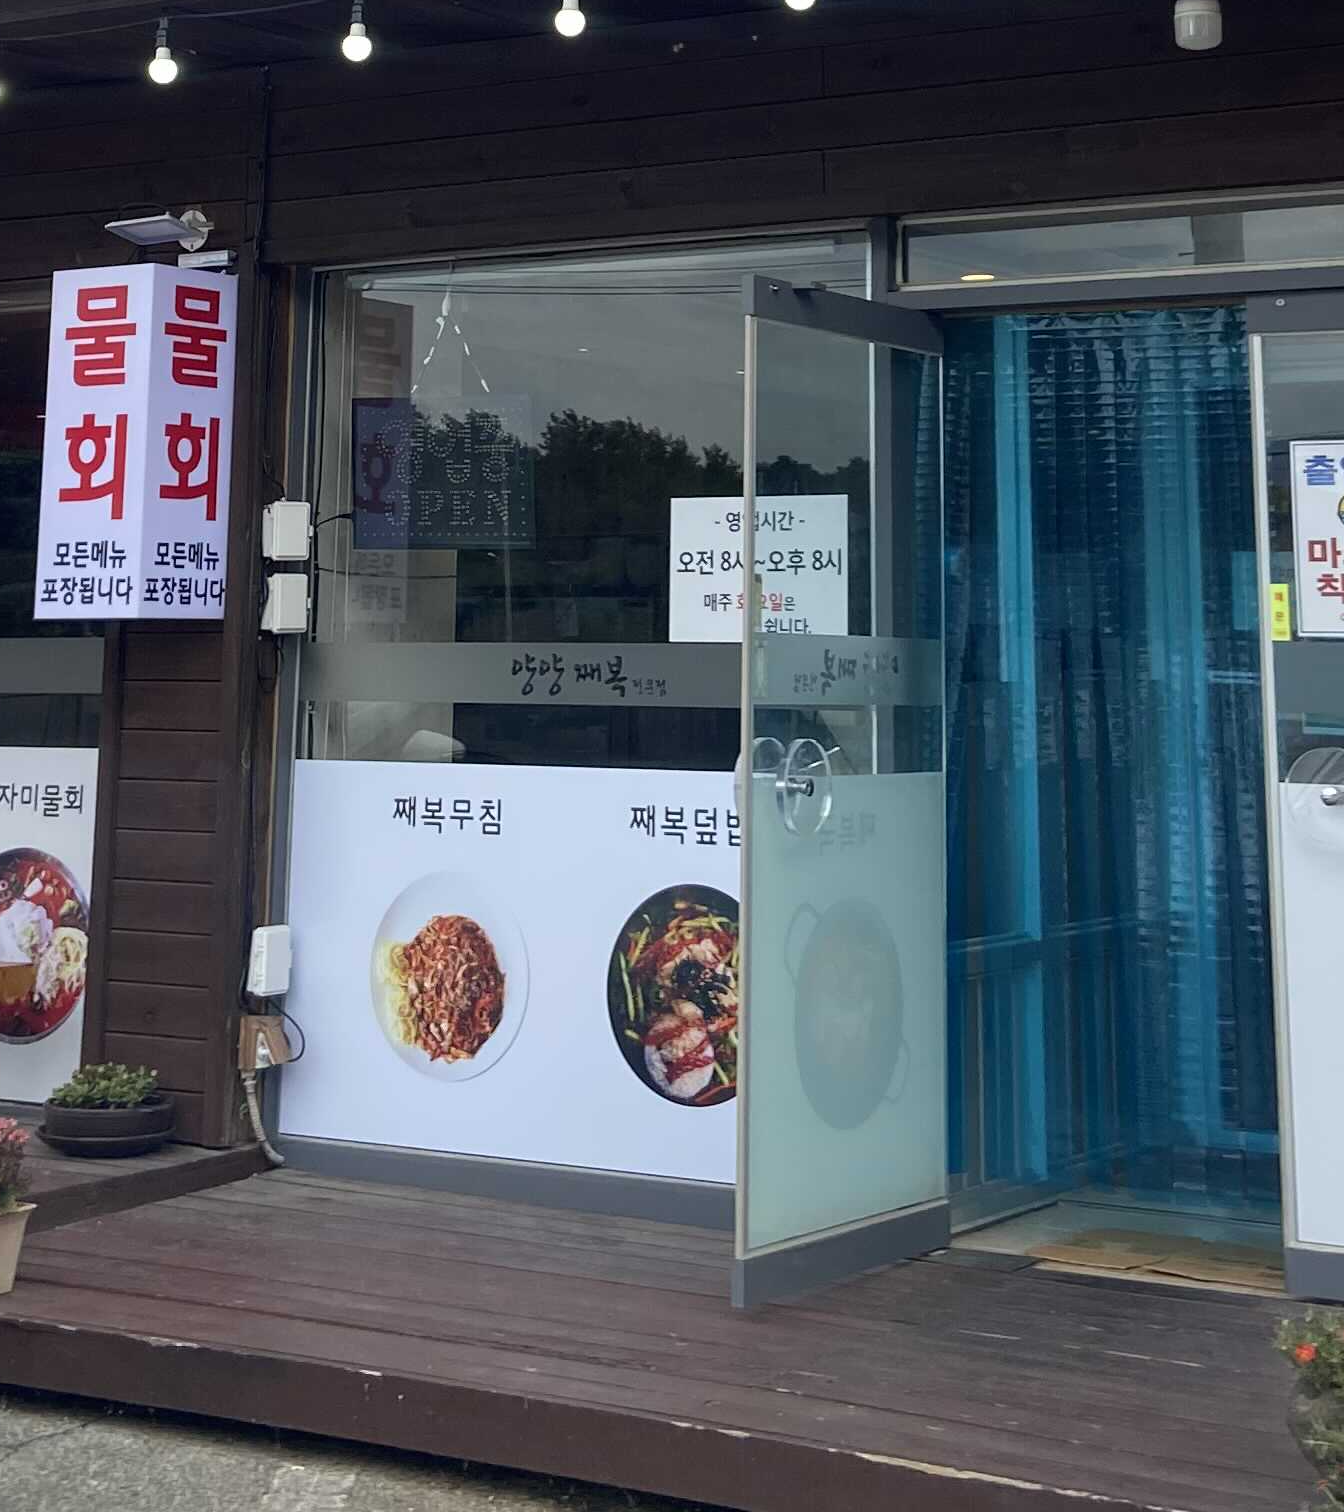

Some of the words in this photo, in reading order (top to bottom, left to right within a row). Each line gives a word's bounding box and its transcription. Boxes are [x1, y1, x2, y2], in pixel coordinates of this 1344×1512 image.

[59, 285, 137, 520] 물회
[160, 285, 228, 521] 물회
[384, 489, 512, 526] OPEN
[53, 541, 127, 569] 모든메뉴
[154, 541, 220, 571] 모든메뉴
[676, 549, 714, 575] 오전
[812, 548, 842, 575] 8시
[41, 575, 133, 606] 포장됩니다
[143, 577, 225, 607] 포장됩니다
[703, 593, 733, 612] 매주
[512, 653, 564, 696] 양양
[392, 796, 503, 836] 째복무침
